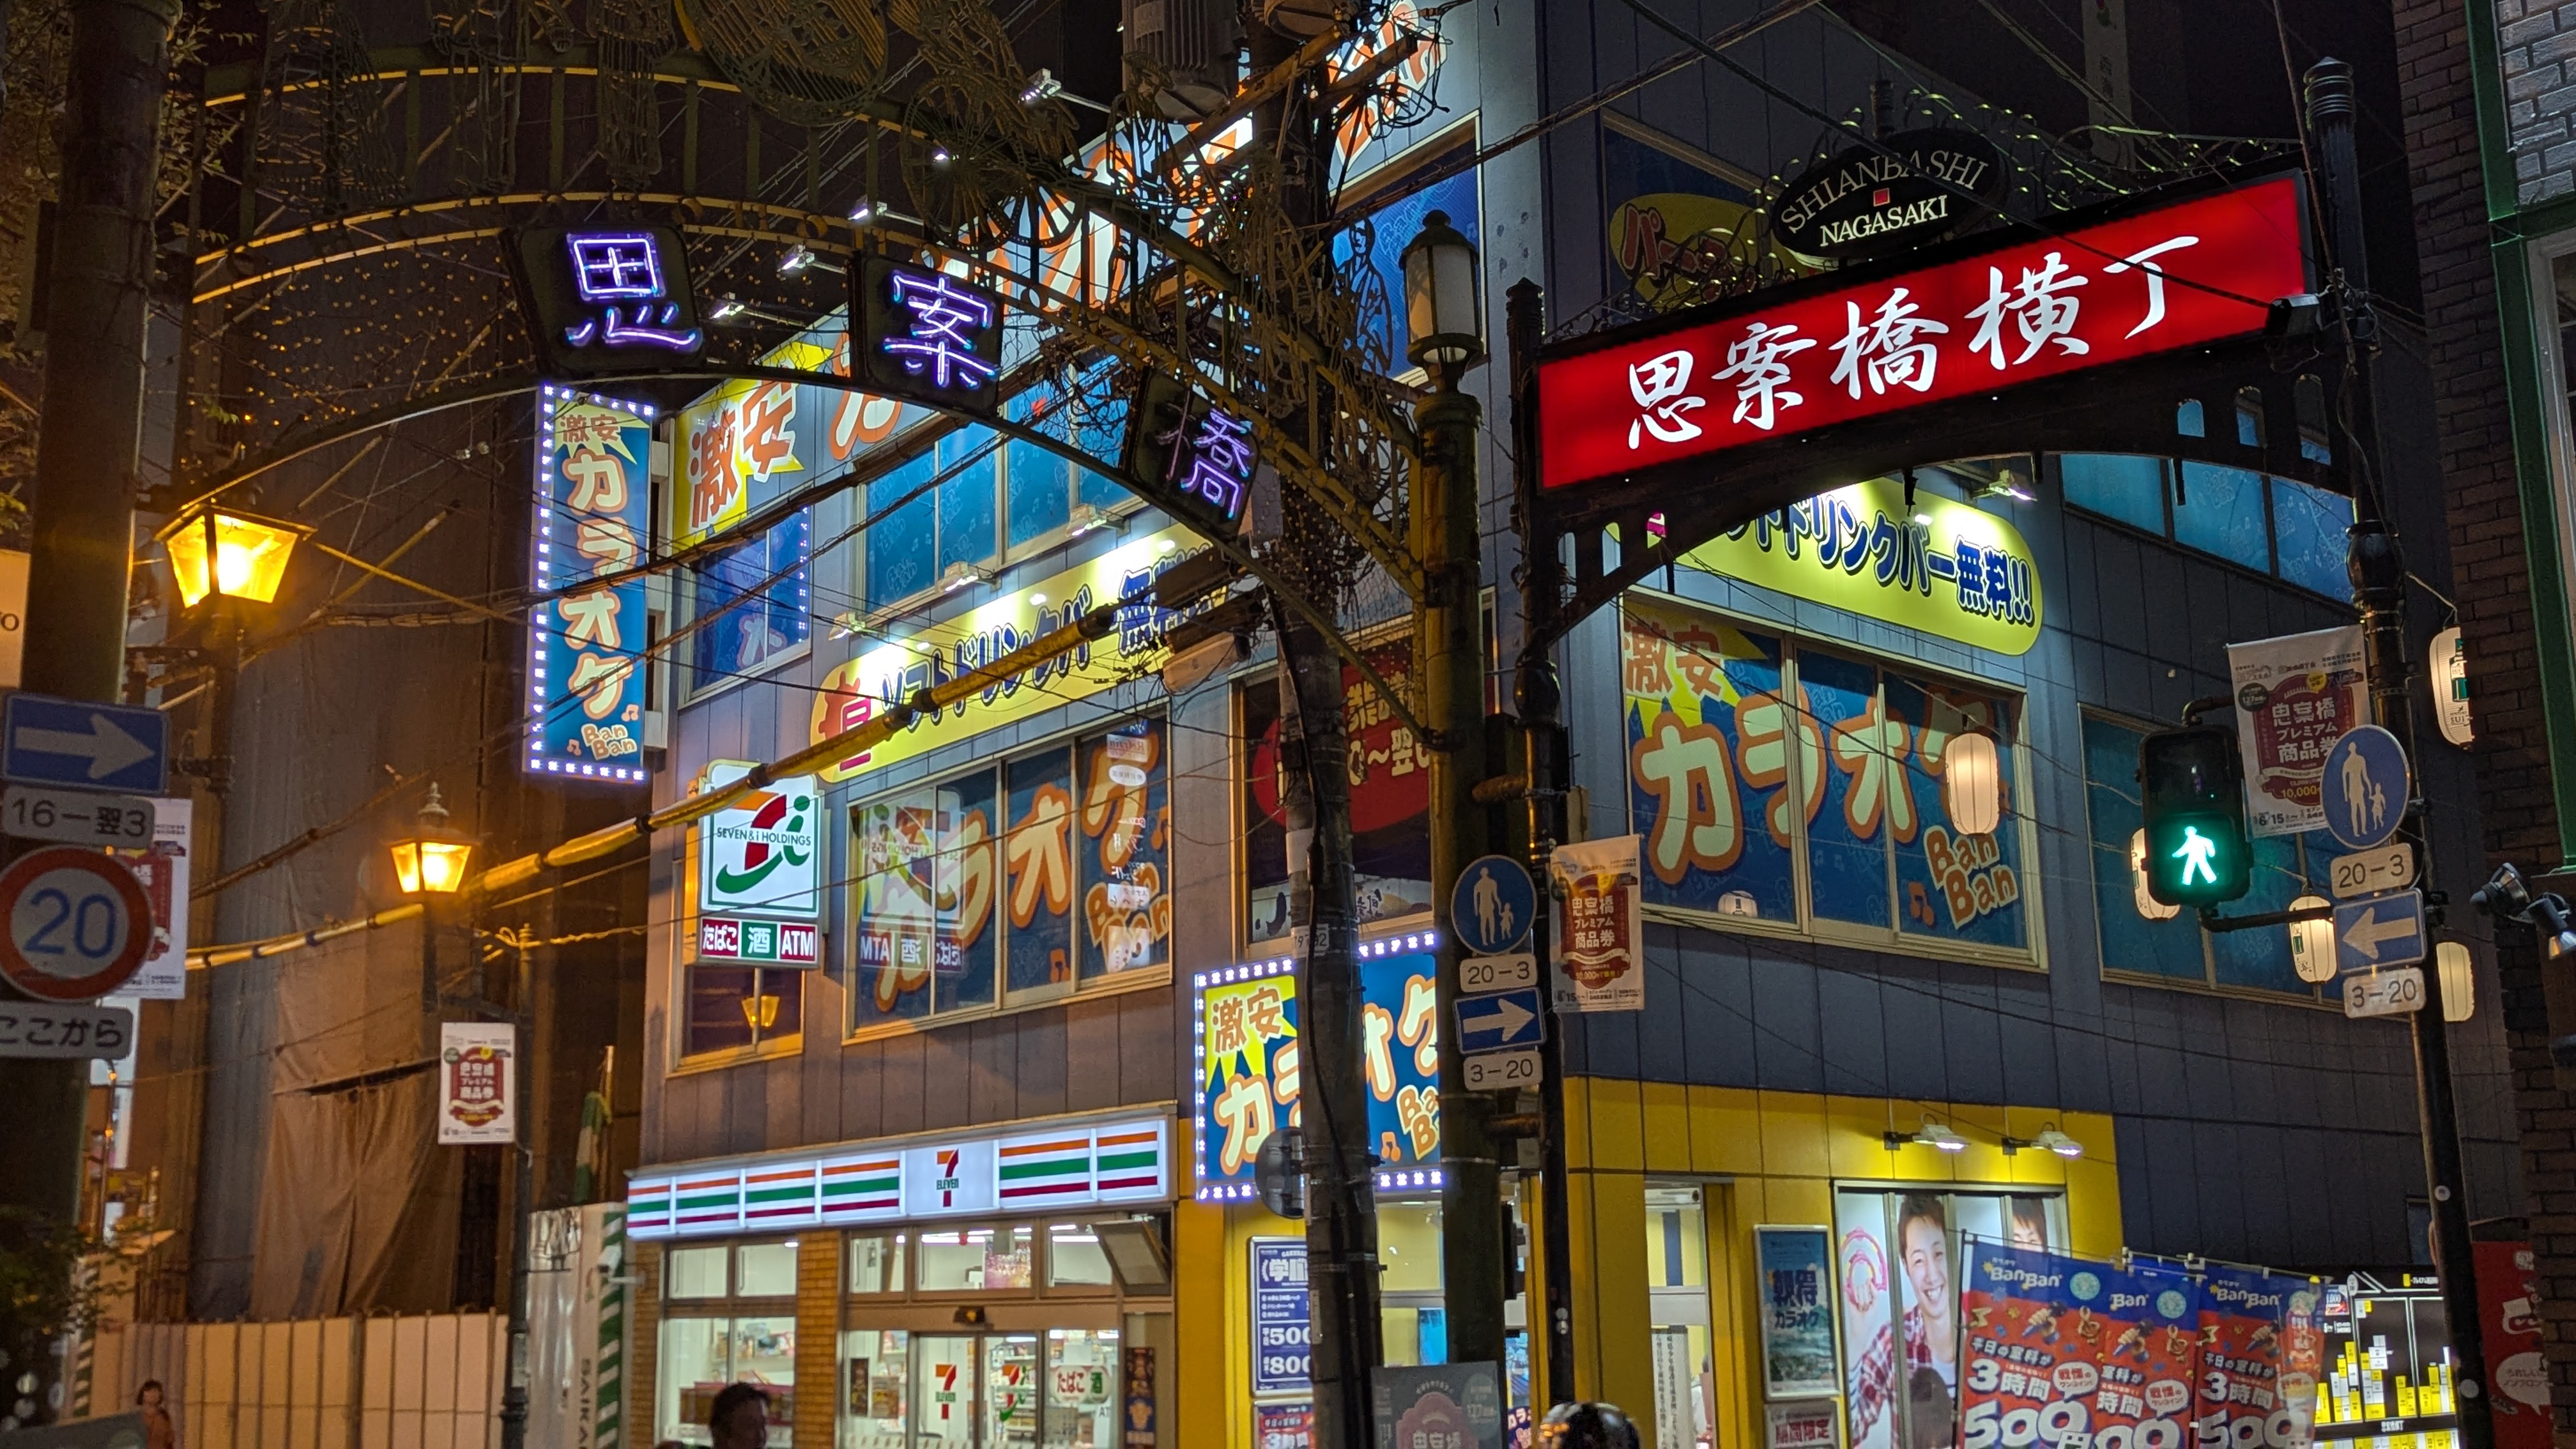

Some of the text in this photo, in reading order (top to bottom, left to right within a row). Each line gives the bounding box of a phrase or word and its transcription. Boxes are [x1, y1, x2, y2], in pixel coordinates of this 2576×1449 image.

[1781, 150, 1989, 234] SHIANBASHI
[1819, 194, 1949, 247] NAGASAKI
[566, 231, 704, 355] 思
[882, 271, 1000, 389] 案
[1628, 234, 2201, 451] 思案橋横丁
[560, 414, 619, 443] 激安
[689, 368, 797, 530] 激安
[558, 448, 638, 721] カラオケ
[1624, 618, 1725, 696] 激安
[2272, 696, 2336, 727] 思案橋
[581, 723, 638, 761] Ban Ban
[2276, 721, 2338, 742] プレミアム
[762, 832, 811, 847] HOLDINGS
[873, 730, 1161, 1013] カラオケ
[1922, 824, 2019, 930] Ban Ban
[2338, 853, 2405, 889] 20-3
[1571, 894, 1615, 917] 思案橋
[23, 887, 117, 958] 20
[702, 925, 738, 951] たばこ
[1574, 917, 1615, 930] プレミアム
[747, 927, 770, 954] 酒
[781, 932, 815, 956] ATM
[1574, 929, 1616, 950] 商品券
[1467, 961, 1531, 985] 20-3
[2352, 978, 2417, 1009] 3-20
[0, 1017, 122, 1048] ここから
[1213, 986, 1284, 1054] 激安
[1470, 1059, 1533, 1083] 3-20
[2110, 1293, 2147, 1308] Ban
[1774, 1310, 1820, 1330] カラオケ
[1057, 1370, 1085, 1394] たばこ
[1967, 1358, 2051, 1402] 3時間
[2200, 1371, 2274, 1409] 3時間
